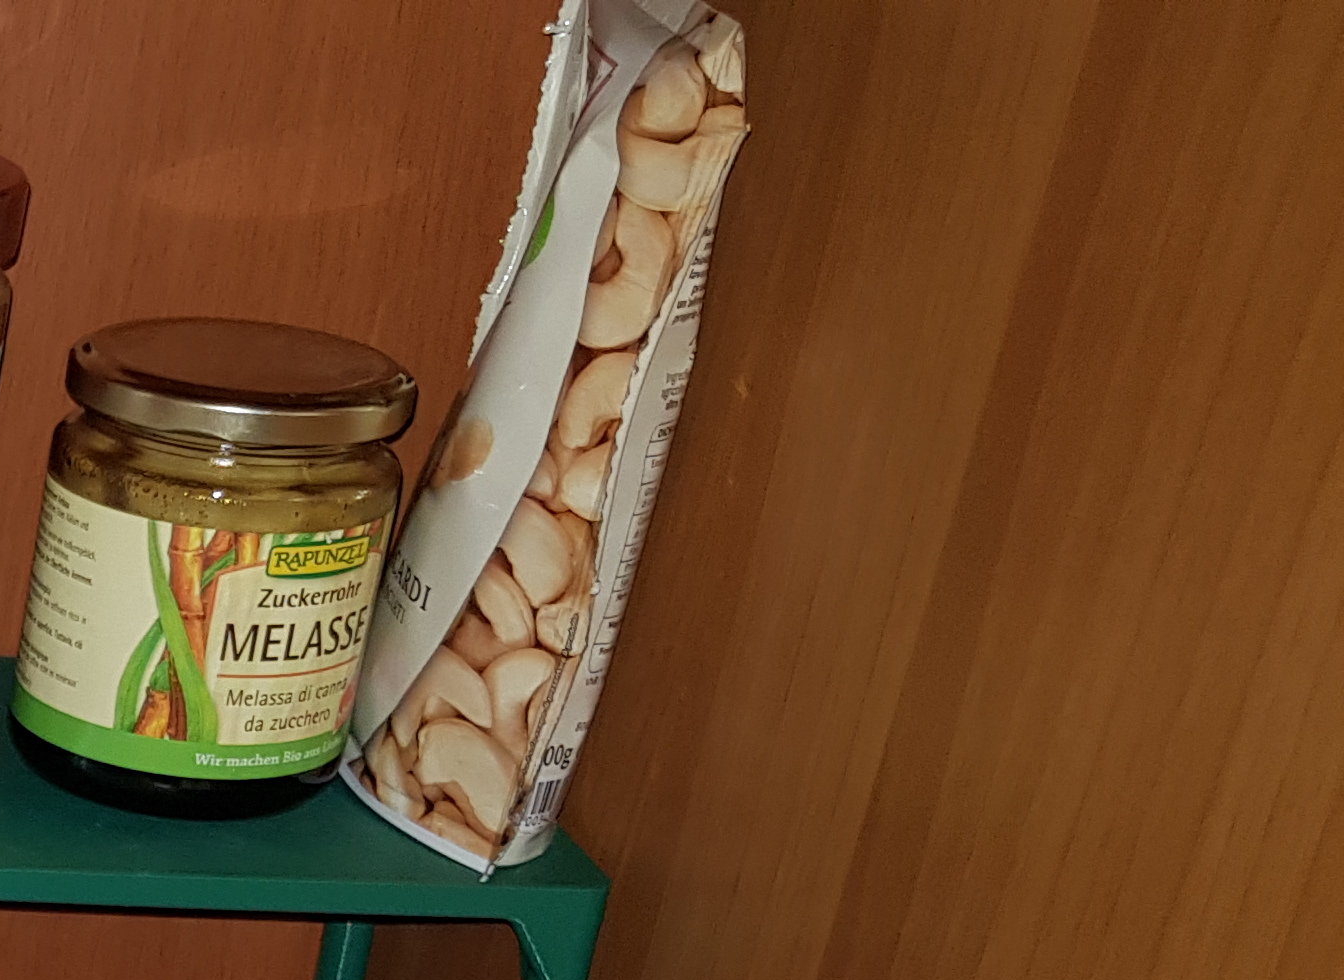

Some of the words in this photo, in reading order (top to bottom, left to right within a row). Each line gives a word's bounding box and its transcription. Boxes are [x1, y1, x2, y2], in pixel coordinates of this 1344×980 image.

[273, 541, 366, 572] RAPUNZEL
[256, 580, 363, 609] Zuckerrohr
[219, 605, 368, 663] MELASSE
[225, 688, 294, 707] Melassa
[297, 684, 313, 703] di
[243, 715, 265, 733] da
[268, 708, 332, 732] zucchero
[194, 752, 224, 767] Wir
[225, 754, 280, 768] machen
[281, 749, 303, 764] Bio
